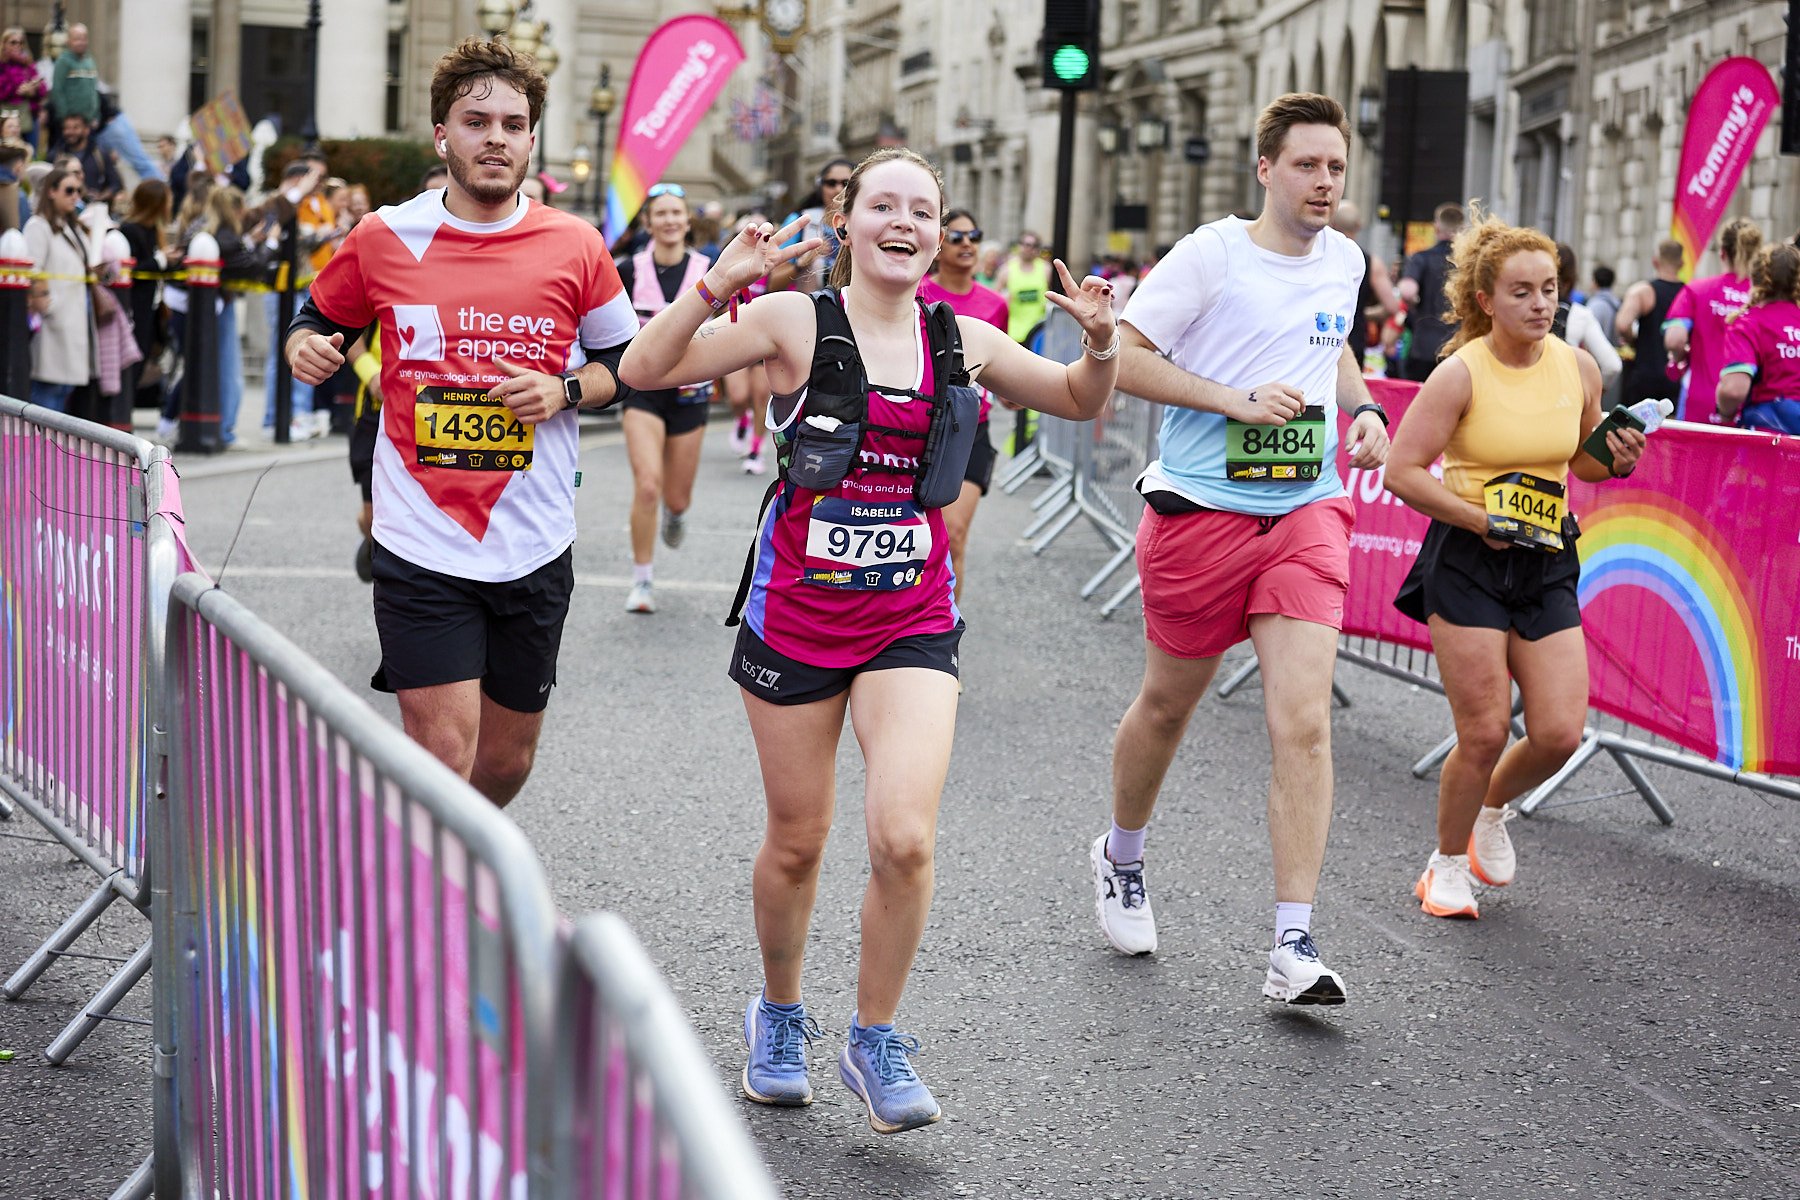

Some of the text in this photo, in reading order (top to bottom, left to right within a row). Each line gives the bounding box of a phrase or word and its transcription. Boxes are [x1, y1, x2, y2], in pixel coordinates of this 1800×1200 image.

[632, 39, 716, 139] Tommy's
[1687, 84, 1754, 198] Tommy's
[457, 306, 556, 336] the eve
[457, 338, 547, 363] appeal
[414, 370, 480, 384] gynaecological
[482, 374, 513, 384] cance
[443, 392, 478, 402] HENRY
[424, 412, 528, 443] 14364
[1242, 428, 1316, 454] 8484
[875, 485, 895, 493] and
[851, 506, 902, 517] ISABELLE
[1493, 489, 1557, 524] 14044
[827, 526, 916, 559] 9794
[741, 654, 756, 678] tcs
